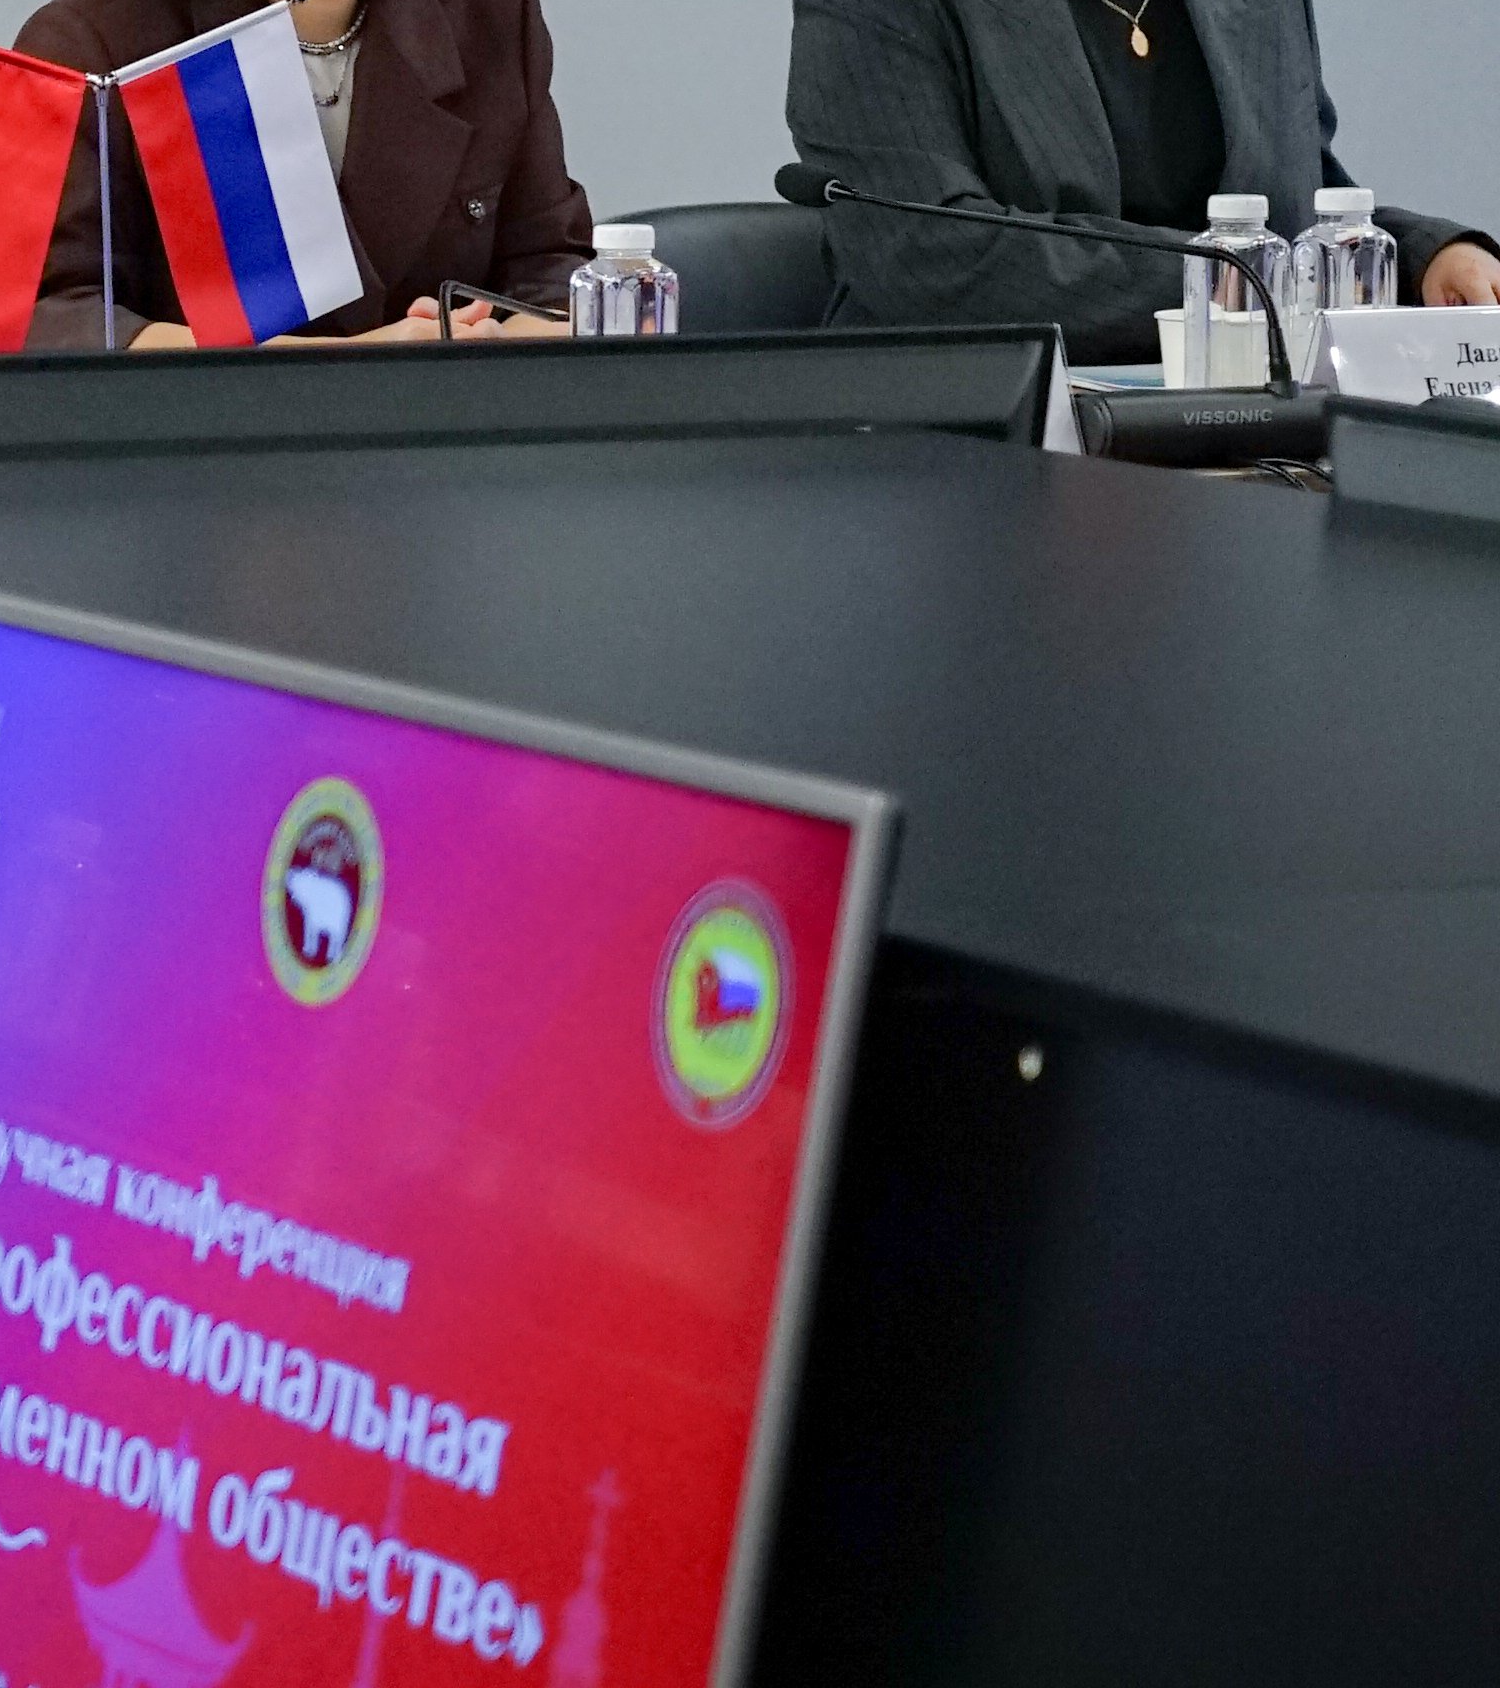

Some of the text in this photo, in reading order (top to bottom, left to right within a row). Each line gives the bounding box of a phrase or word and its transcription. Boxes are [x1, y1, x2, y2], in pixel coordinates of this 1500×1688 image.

[1183, 408, 1274, 425] VISSONIC
[114, 1162, 411, 1314] конференция
[208, 1466, 544, 1666] обществе»
